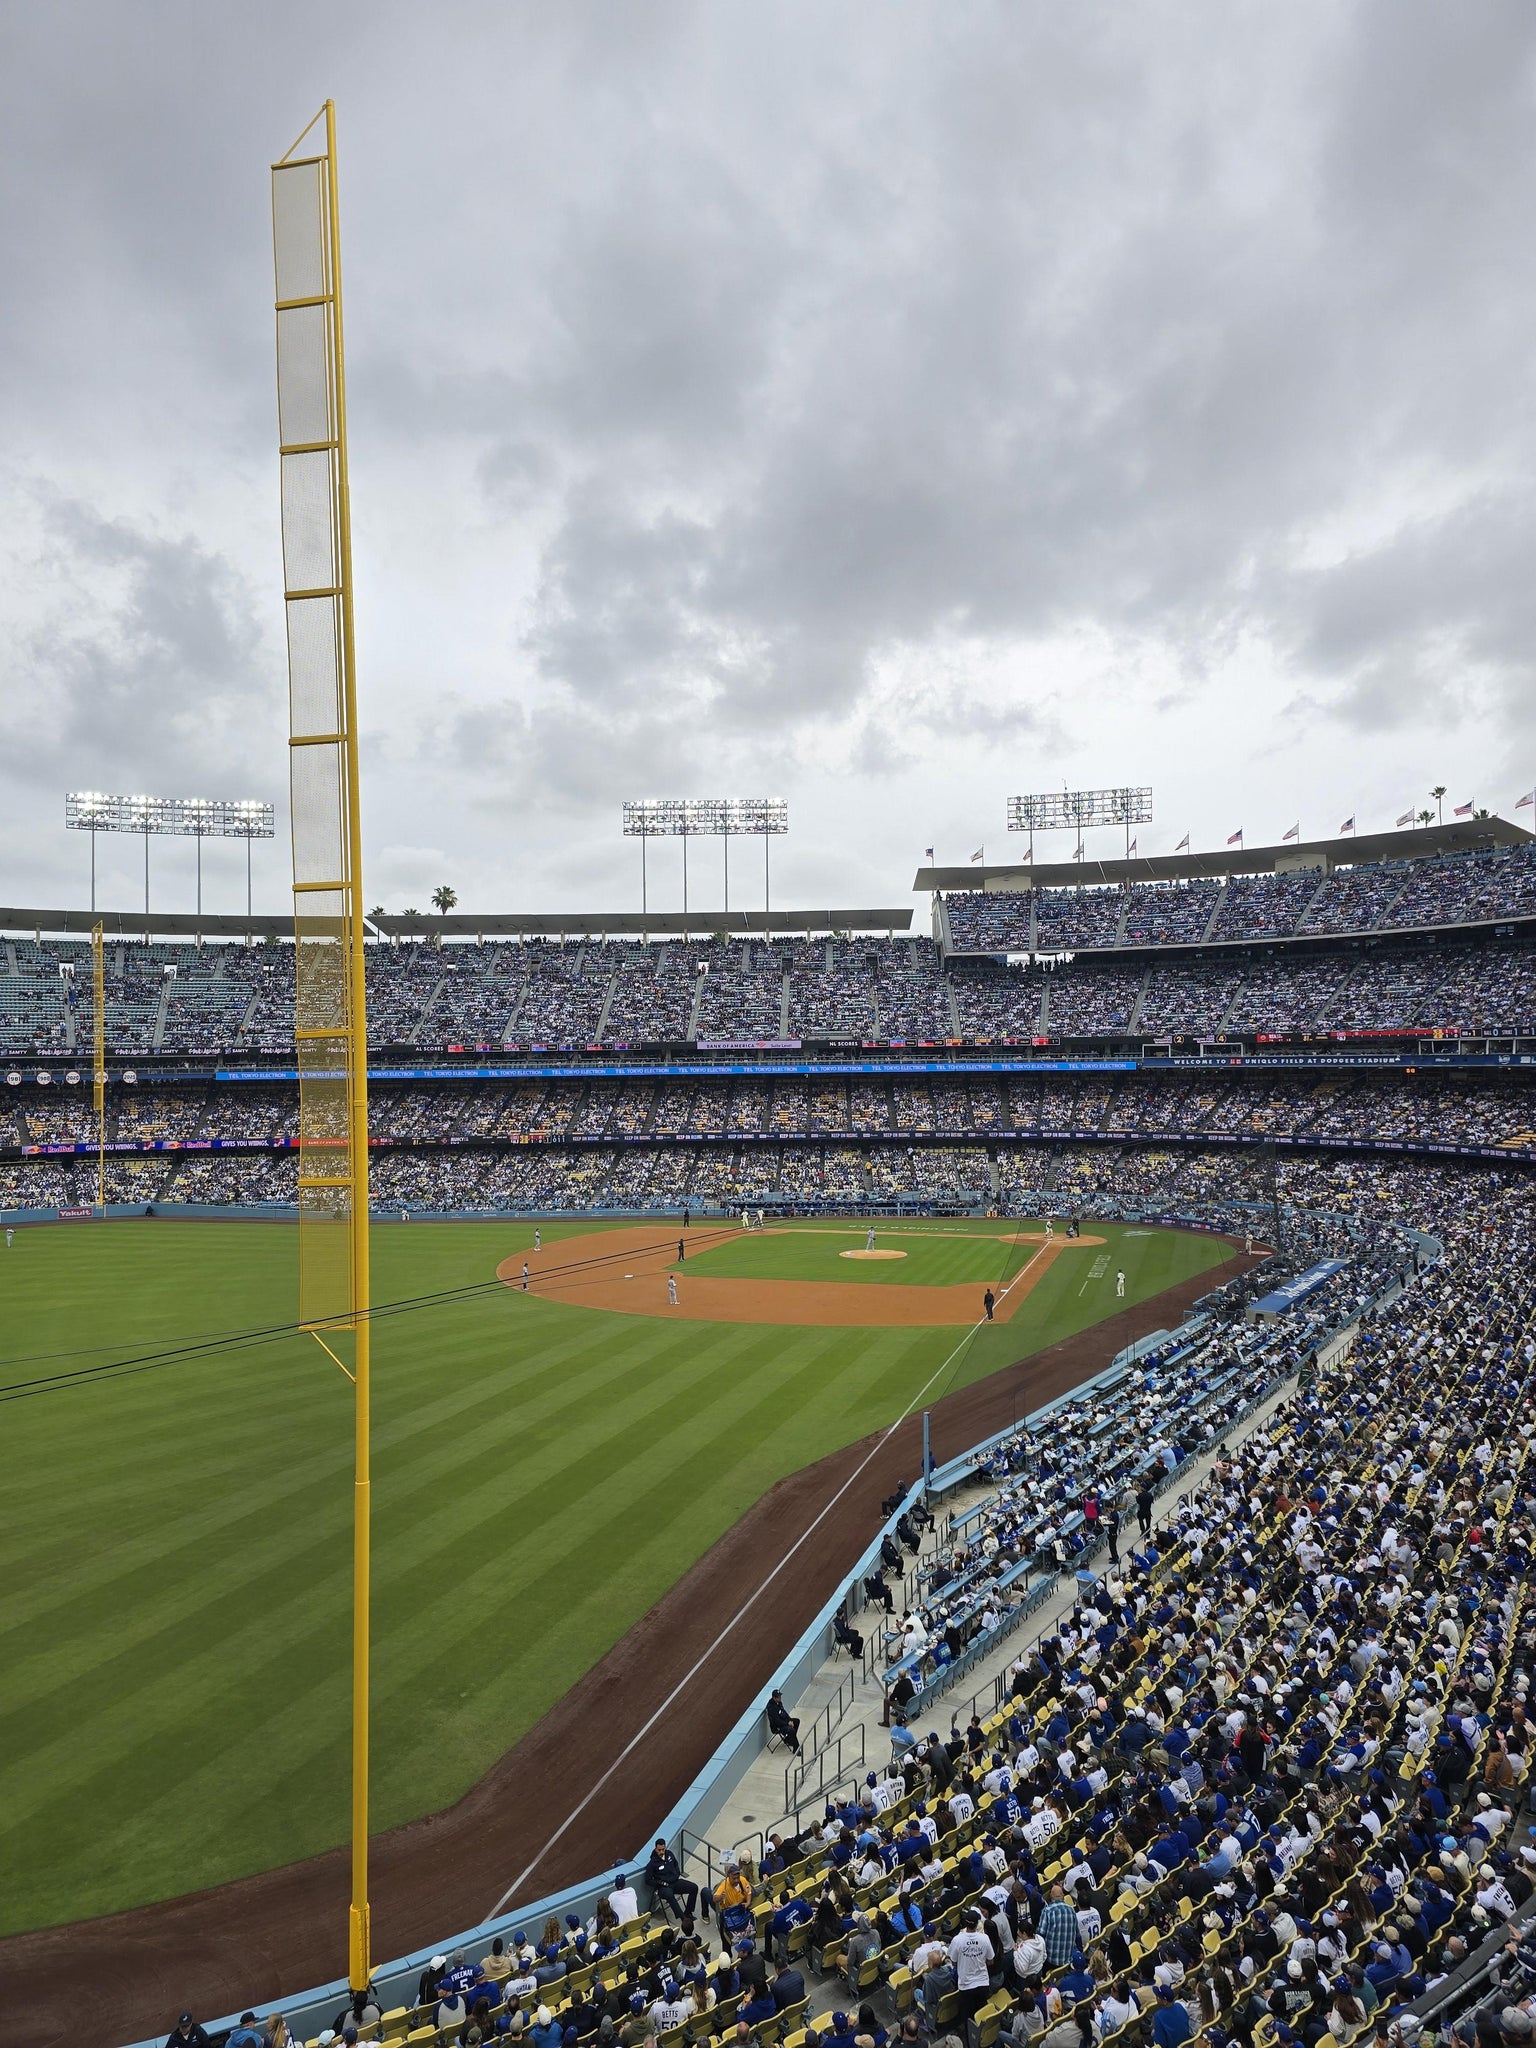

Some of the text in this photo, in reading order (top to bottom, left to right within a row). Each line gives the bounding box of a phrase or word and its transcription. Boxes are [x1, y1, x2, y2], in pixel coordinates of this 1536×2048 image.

[60, 1208, 91, 1216] Yakult
[1090, 1692, 1097, 1705] 17
[894, 1789, 902, 1800] 17
[1185, 1792, 1190, 1801] 5
[881, 1796, 888, 1806] 17
[961, 1807, 969, 1820] 18
[1008, 1807, 1021, 1822] 50
[1043, 1822, 1057, 1836] 50
[929, 1830, 937, 1844] 17
[1033, 1834, 1044, 1846] 50
[996, 1859, 1005, 1871] 13
[1288, 1855, 1296, 1869] 3
[1504, 1895, 1515, 1911] 5
[1088, 1924, 1099, 1936] 18
[451, 1969, 474, 1982] FREEMAN
[460, 1979, 469, 1990] 5
[662, 2010, 679, 2019] BETTS
[661, 2021, 678, 2030] 50
